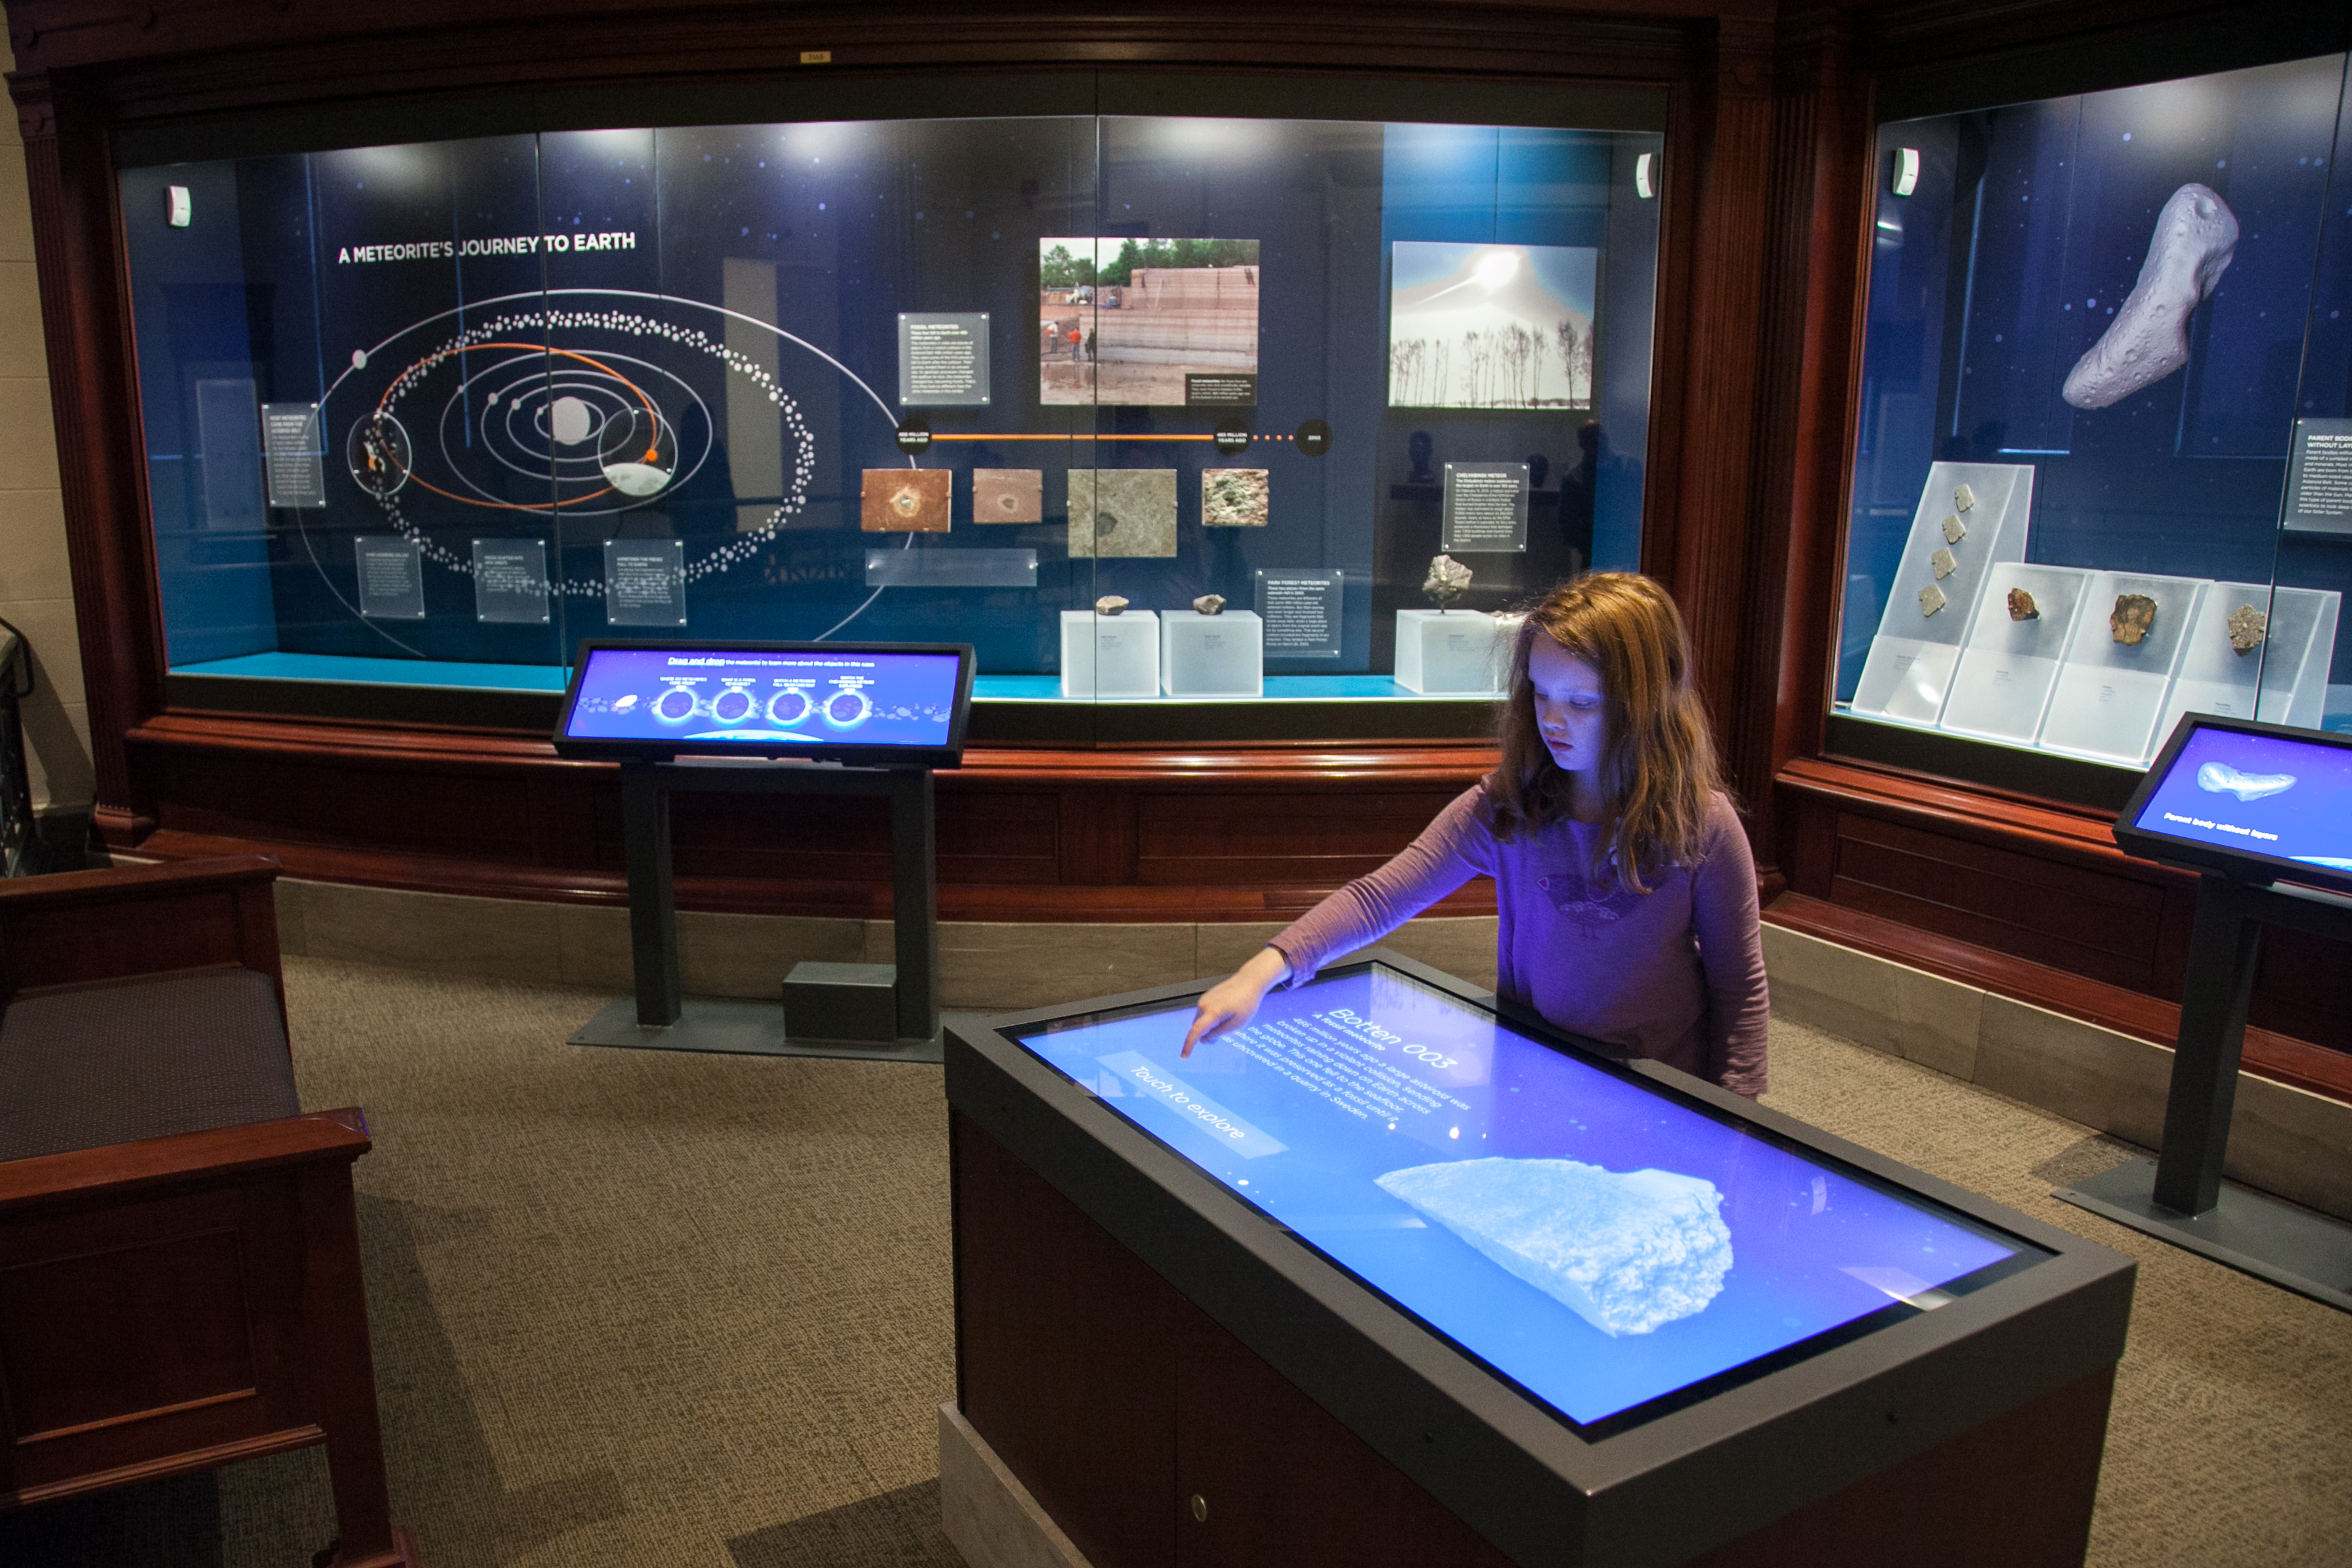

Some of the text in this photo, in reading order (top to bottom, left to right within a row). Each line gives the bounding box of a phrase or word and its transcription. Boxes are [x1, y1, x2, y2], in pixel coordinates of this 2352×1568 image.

[338, 231, 636, 264] A METEORITE'S JOURNEY TO EARTH
[668, 657, 689, 666] Drag
[689, 657, 706, 666] and
[706, 657, 726, 667] drop
[2164, 812, 2278, 841] Parent body without layers
[1248, 1026, 1263, 1035] the
[1259, 1035, 1286, 1049] globe.
[1288, 1048, 1306, 1059] This
[1304, 1058, 1323, 1068] one
[1322, 1067, 1340, 1077] fell
[1348, 1081, 1365, 1091] the
[1262, 1024, 1305, 1047] meteorites
[1303, 1046, 1335, 1063] raining
[1333, 1062, 1360, 1077] down
[1372, 1083, 1399, 1098] Earth
[1398, 1097, 1431, 1114] across
[1277, 1020, 1306, 1037] broken
[1334, 1051, 1365, 1068] violent
[1364, 1066, 1401, 1088] collision,
[1402, 1086, 1442, 1108] sending
[1293, 1018, 1312, 1028] 466
[1309, 1027, 1338, 1042] million
[1334, 1041, 1361, 1054] years
[1360, 1053, 1379, 1063] ago
[1385, 1066, 1410, 1079] large
[1410, 1079, 1452, 1100] asteroid
[1450, 1098, 1471, 1110] was
[1321, 1018, 1347, 1030] fossil
[1343, 1029, 1385, 1051] meteorite
[1328, 1009, 1458, 1068] Botten 003
[1130, 1066, 1245, 1139] Touch to explore
[1232, 1042, 1278, 1066] uncovered
[1290, 1075, 1322, 1091] quarry
[1330, 1097, 1368, 1120] Sweden.
[1234, 1031, 1257, 1045] where
[1264, 1047, 1282, 1058] was
[1278, 1057, 1326, 1081] preserved
[1341, 1091, 1370, 1105] fossil
[1366, 1104, 1392, 1118] until
